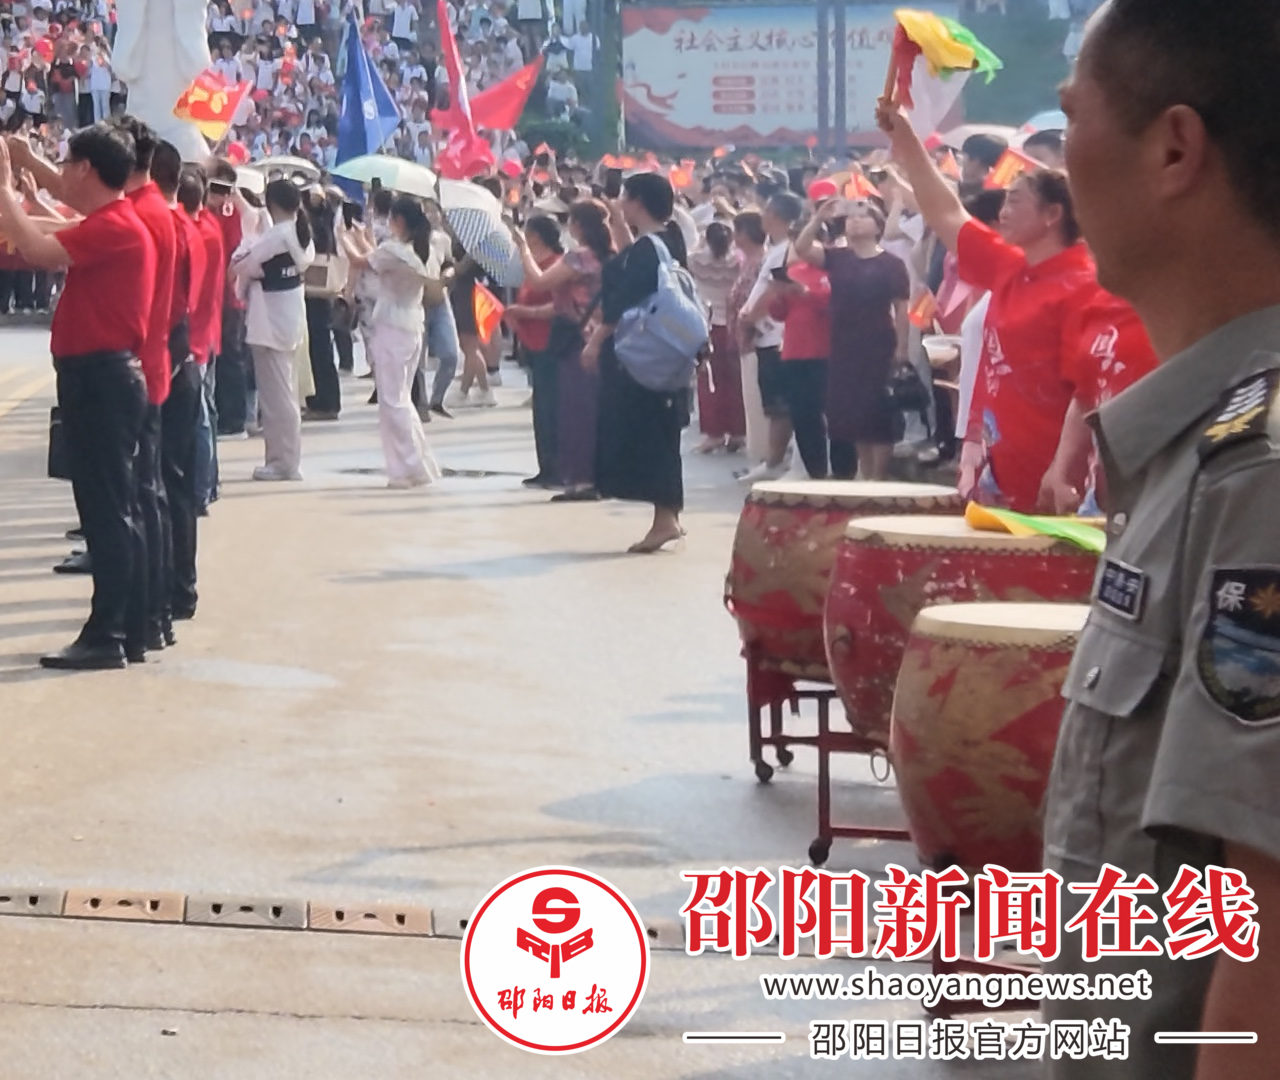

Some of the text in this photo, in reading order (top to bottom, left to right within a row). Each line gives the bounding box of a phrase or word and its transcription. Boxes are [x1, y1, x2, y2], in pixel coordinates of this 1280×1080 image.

[674, 27, 893, 53] 社会主义核心值
[1215, 579, 1248, 612] 保
